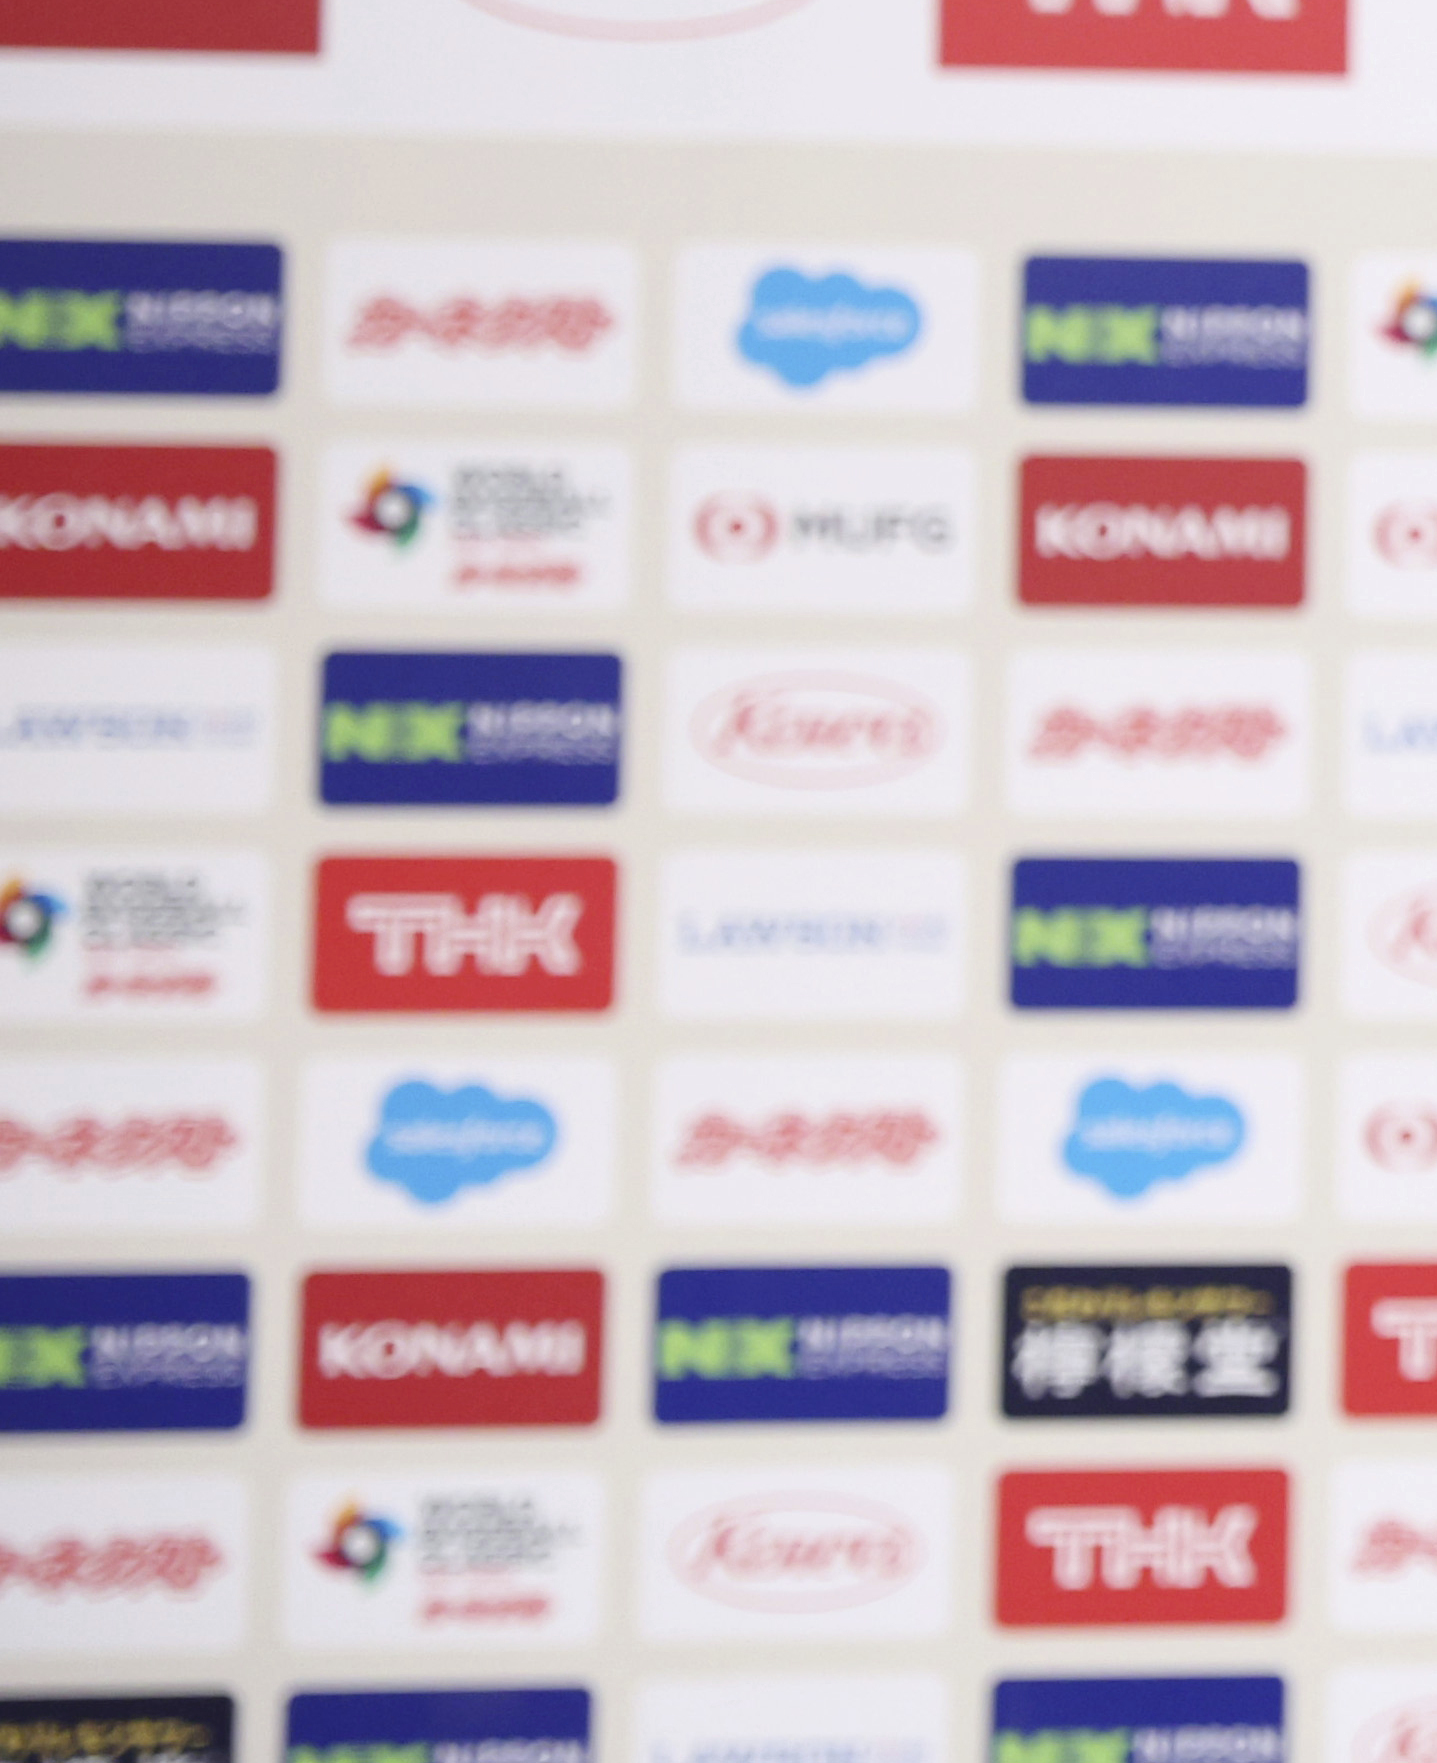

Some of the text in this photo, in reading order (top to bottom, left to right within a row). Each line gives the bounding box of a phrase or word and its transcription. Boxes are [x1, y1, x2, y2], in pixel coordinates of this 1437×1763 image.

[1034, 503, 1291, 560] KONAMI
[346, 893, 582, 976] THK
[317, 1321, 587, 1379] KONAMI
[1025, 1504, 1257, 1590] THK
